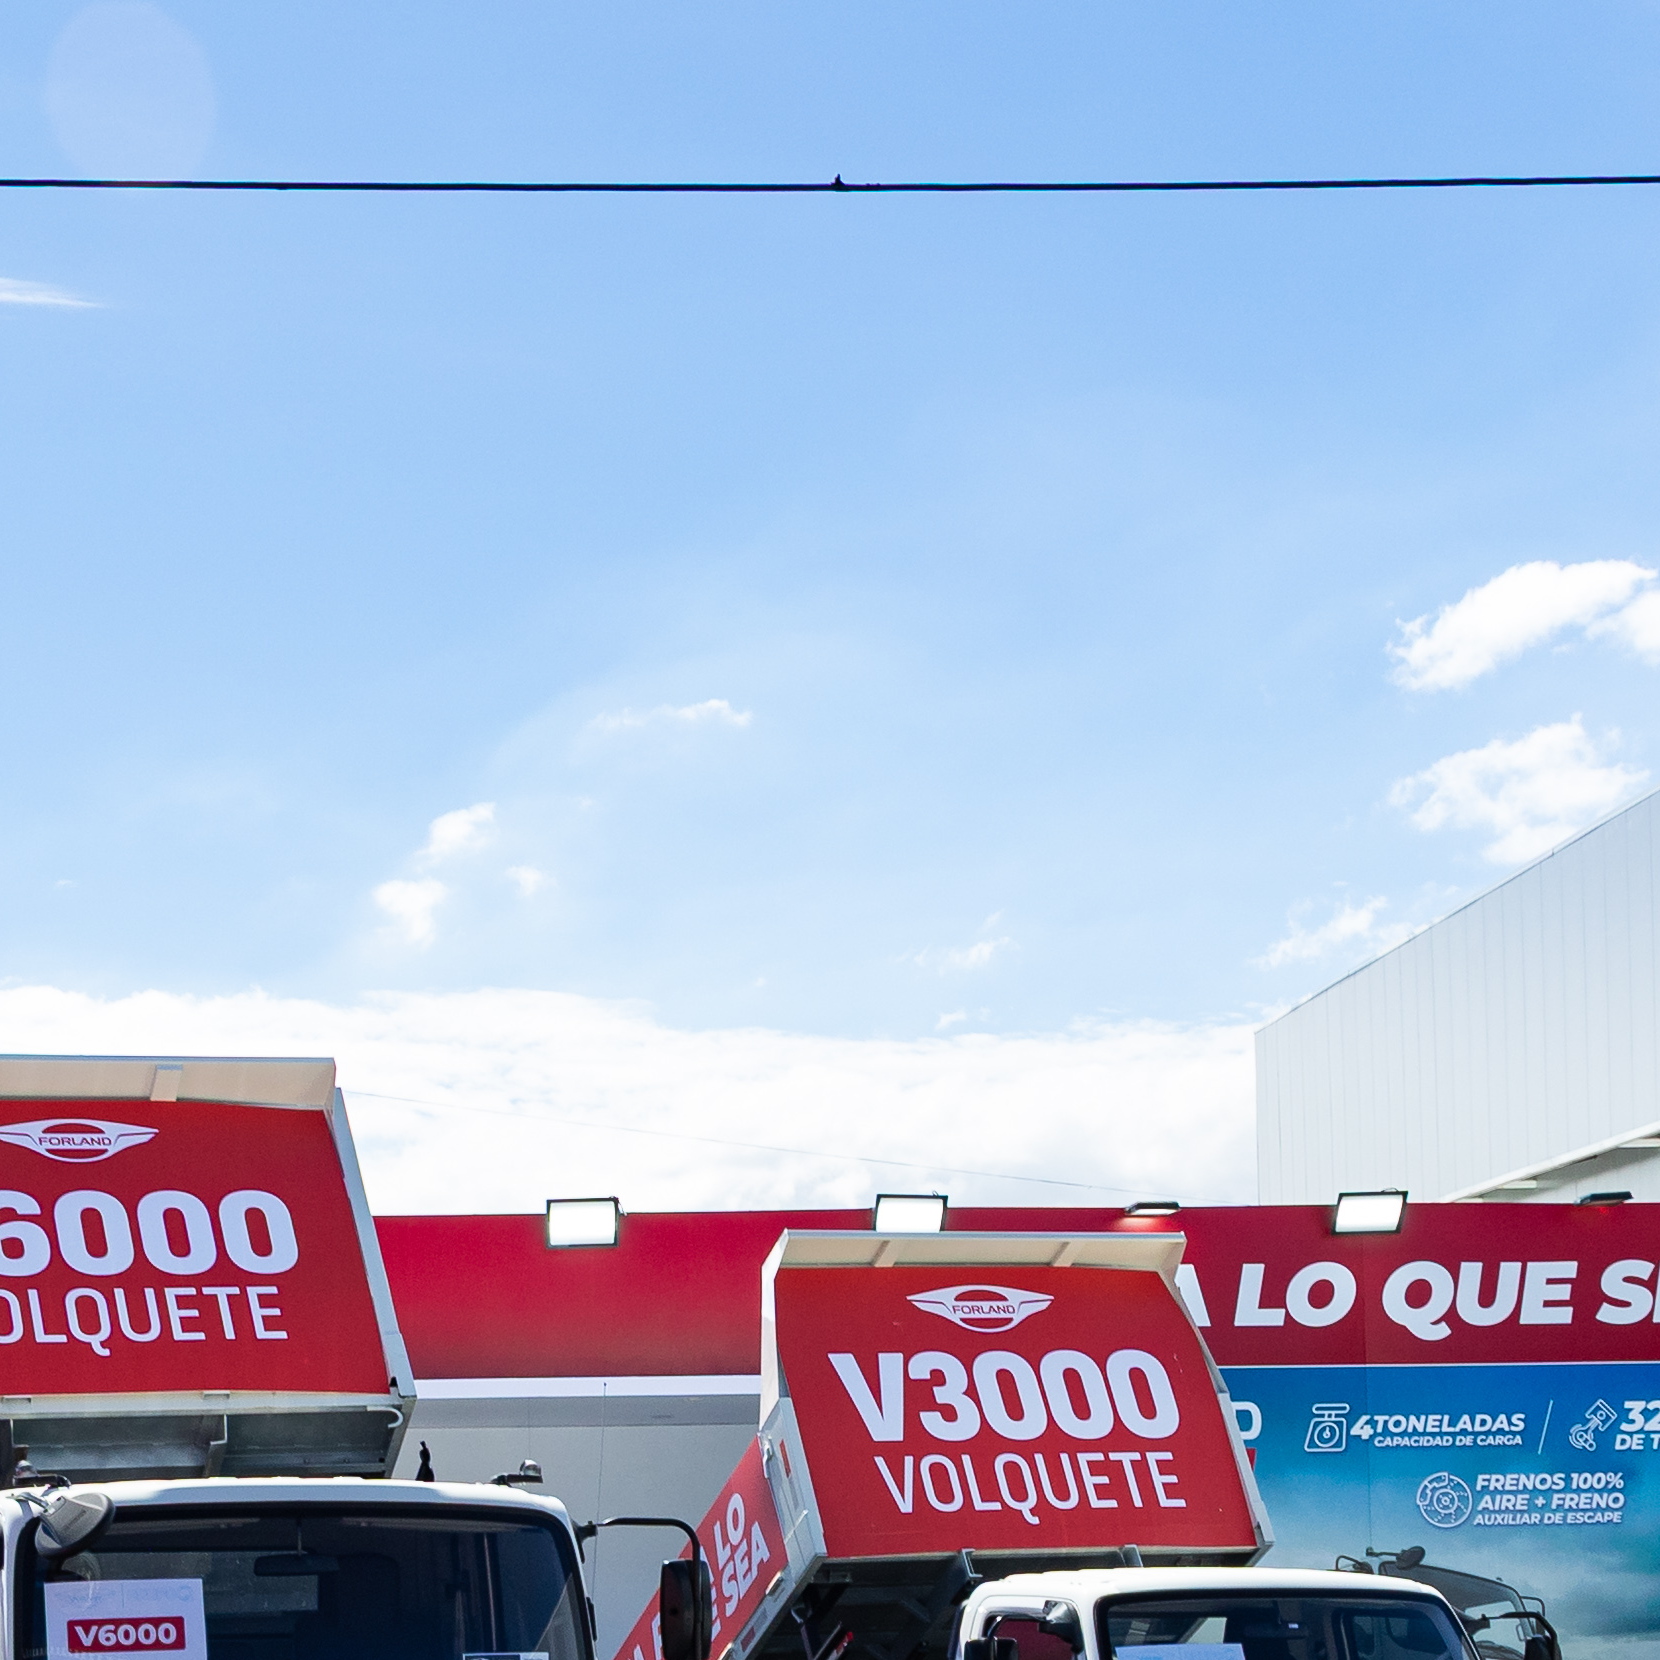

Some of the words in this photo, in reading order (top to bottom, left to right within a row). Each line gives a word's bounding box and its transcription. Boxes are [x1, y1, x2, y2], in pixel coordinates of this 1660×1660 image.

[38, 1135, 113, 1147] FORLAND
[952, 1304, 1016, 1316] FORLAND
[1234, 1261, 1357, 1328] LO
[1381, 1260, 1578, 1341] QUE
[827, 1349, 1180, 1442] V3000
[1350, 1415, 1374, 1440] 4
[1374, 1413, 1526, 1433] TONELADAS
[1374, 1435, 1453, 1447] CAPACIDAD
[1455, 1435, 1474, 1447] DE
[1476, 1435, 1522, 1446] CARGA
[1614, 1434, 1647, 1451] DE
[873, 1451, 1187, 1525] VOLQUETE
[1475, 1473, 1565, 1492] FRENOS
[1570, 1472, 1625, 1490] 100%
[1477, 1494, 1529, 1511] AIRE
[1551, 1493, 1625, 1510] FRENO
[1473, 1512, 1540, 1525] AUXILIAR
[1544, 1513, 1564, 1525] DE
[1567, 1512, 1622, 1524] ESCAPE
[714, 1493, 745, 1570] LO
[722, 1521, 770, 1618] SEA
[74, 1622, 177, 1646] V6000
